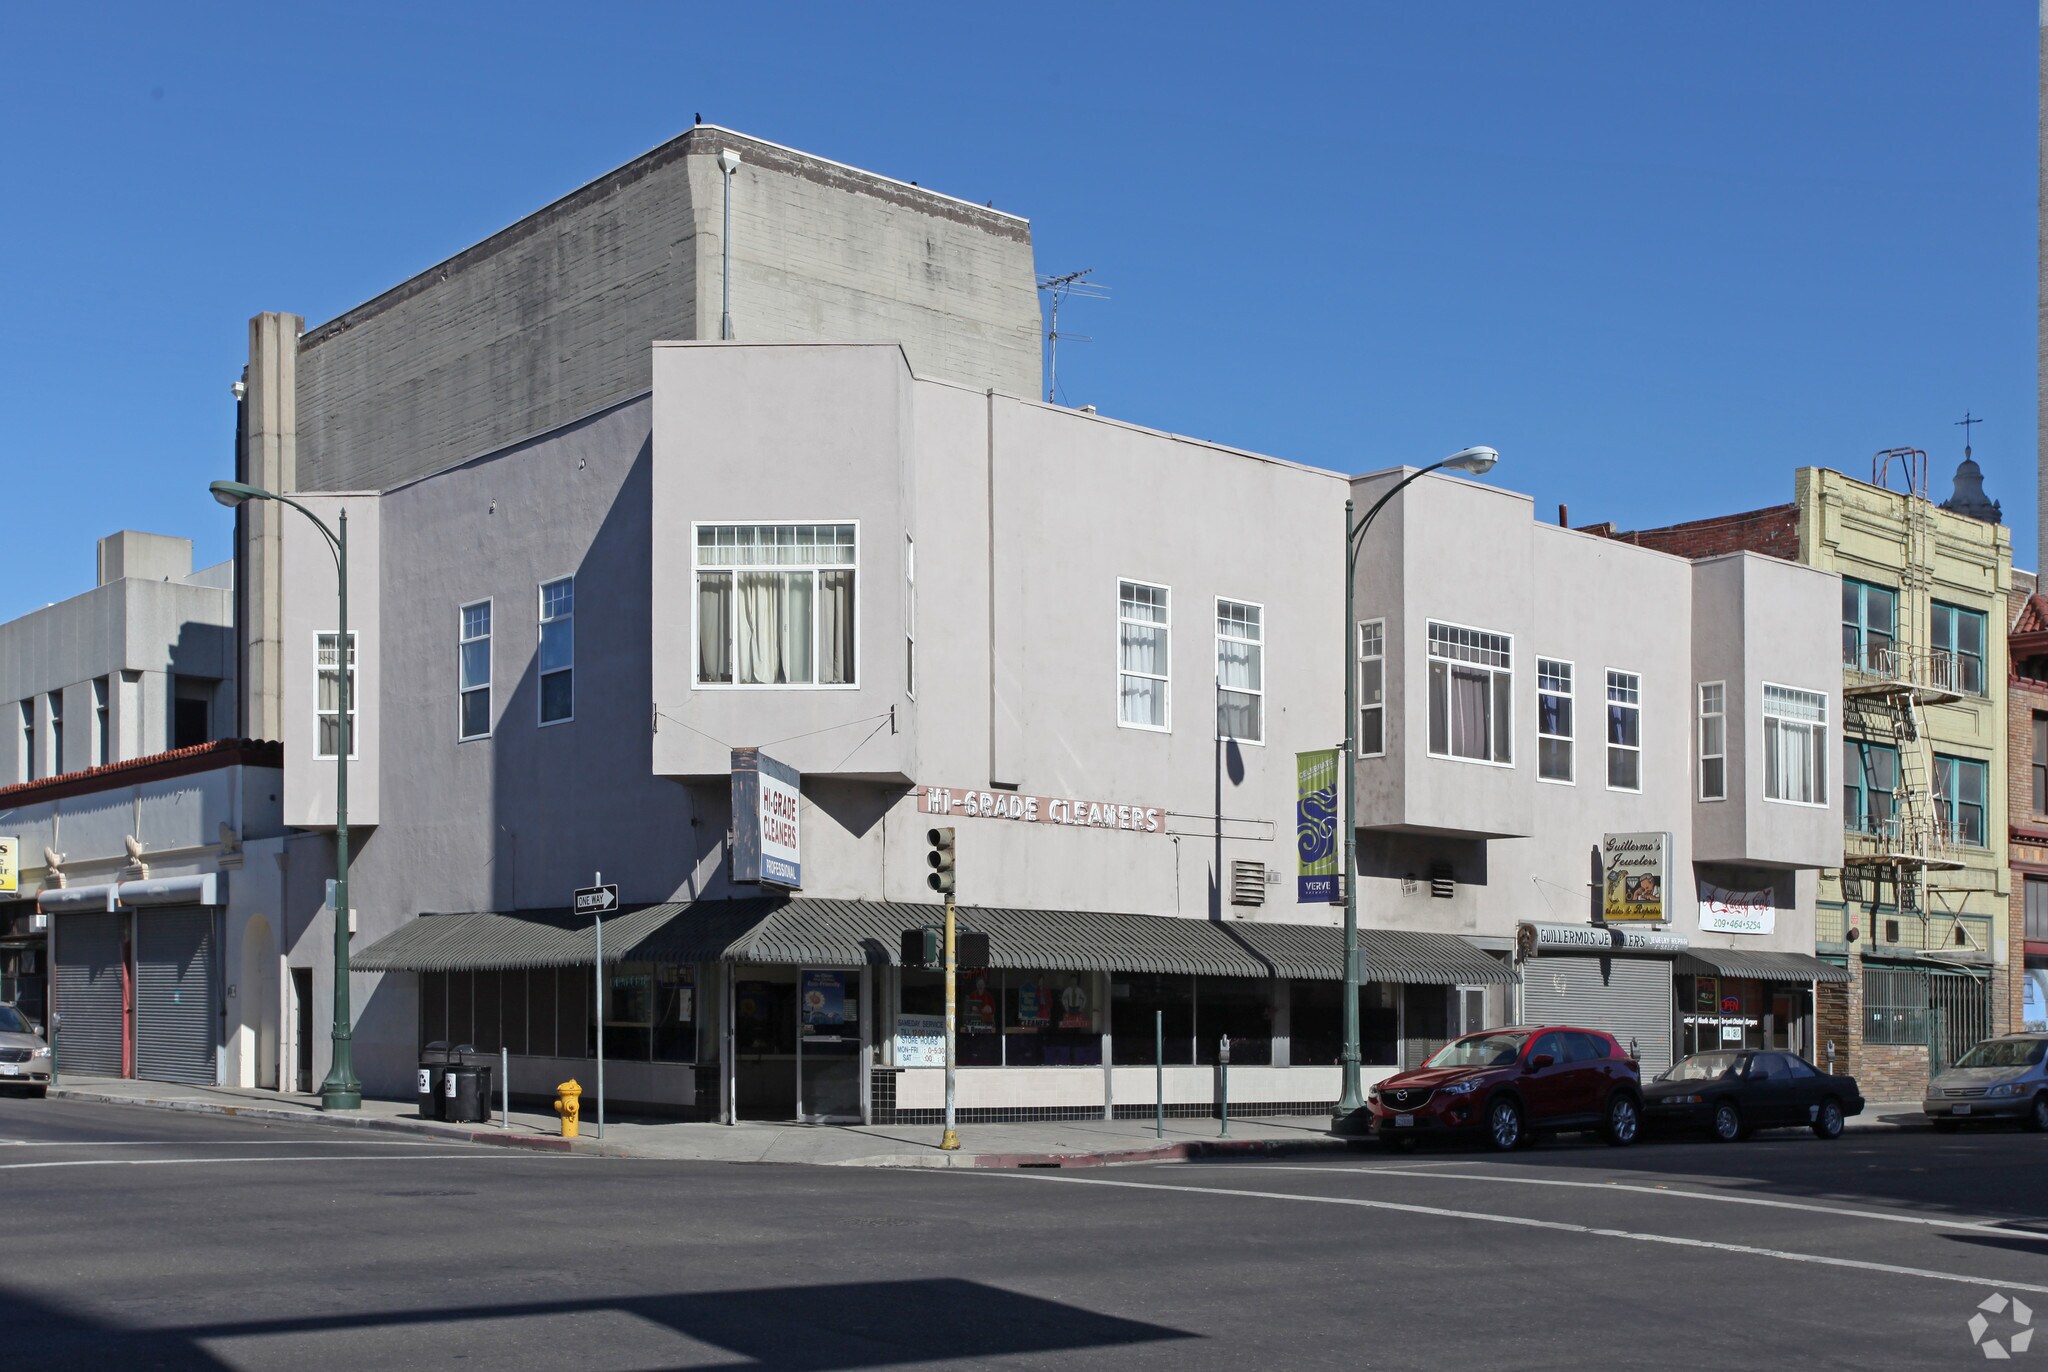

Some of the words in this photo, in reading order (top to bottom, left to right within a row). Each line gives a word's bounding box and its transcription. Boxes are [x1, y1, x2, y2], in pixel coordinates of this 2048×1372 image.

[763, 786, 796, 822] HI-GRADE
[927, 787, 1038, 822] HI-GRADE
[1048, 799, 1159, 832] CLEANERS
[763, 815, 797, 849] CLEANERS
[1605, 837, 1661, 852] Guillermo's
[765, 858, 797, 880] PROFESSIONAL
[1606, 852, 1658, 871] Jewelers
[1305, 881, 1331, 891] VERVE
[578, 895, 590, 907] ONE
[591, 893, 604, 905] WAY
[922, 1020, 944, 1028] SERVICE
[901, 1035, 919, 1044] STORE
[920, 1037, 938, 1045] HOURS
[902, 1054, 912, 1062] SAT
